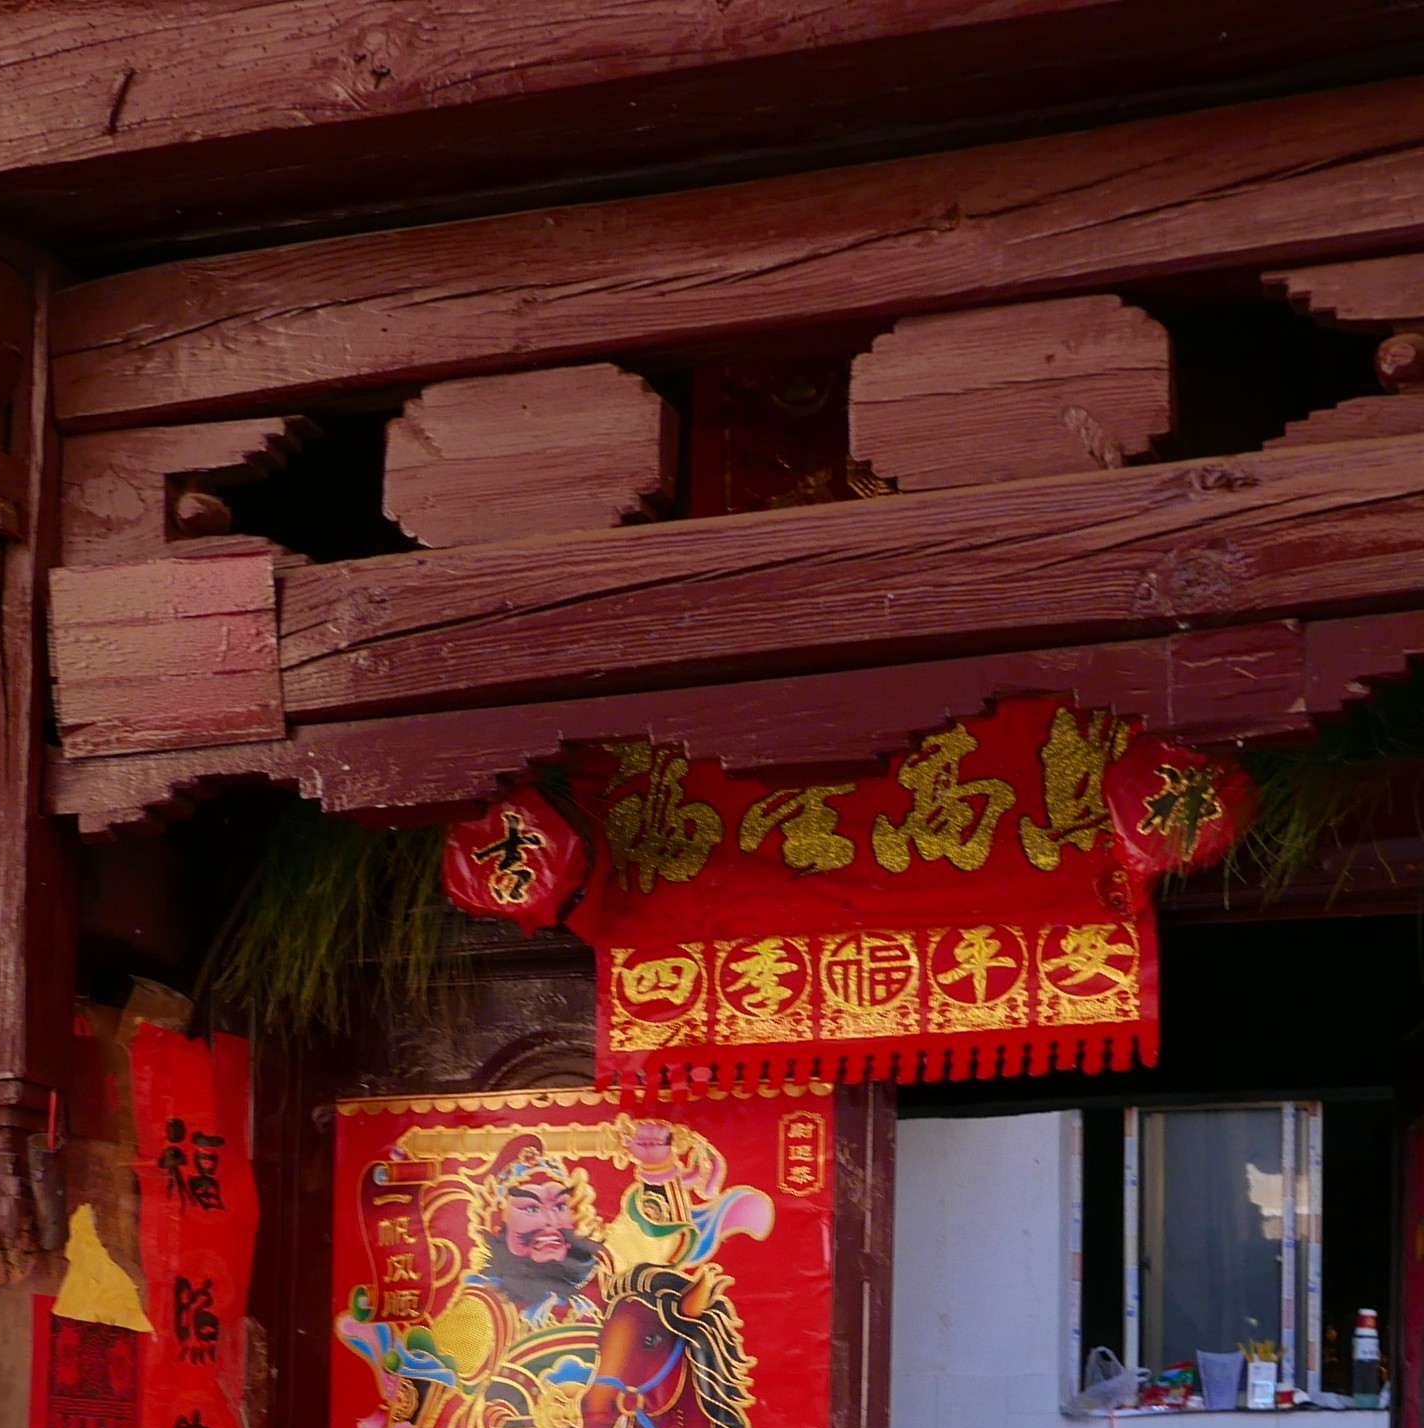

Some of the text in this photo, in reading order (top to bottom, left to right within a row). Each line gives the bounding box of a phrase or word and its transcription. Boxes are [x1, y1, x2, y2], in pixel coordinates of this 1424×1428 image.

[472, 811, 547, 906] 吉
[1136, 762, 1224, 863] 祥
[373, 1193, 423, 1319] 一帆风顺
